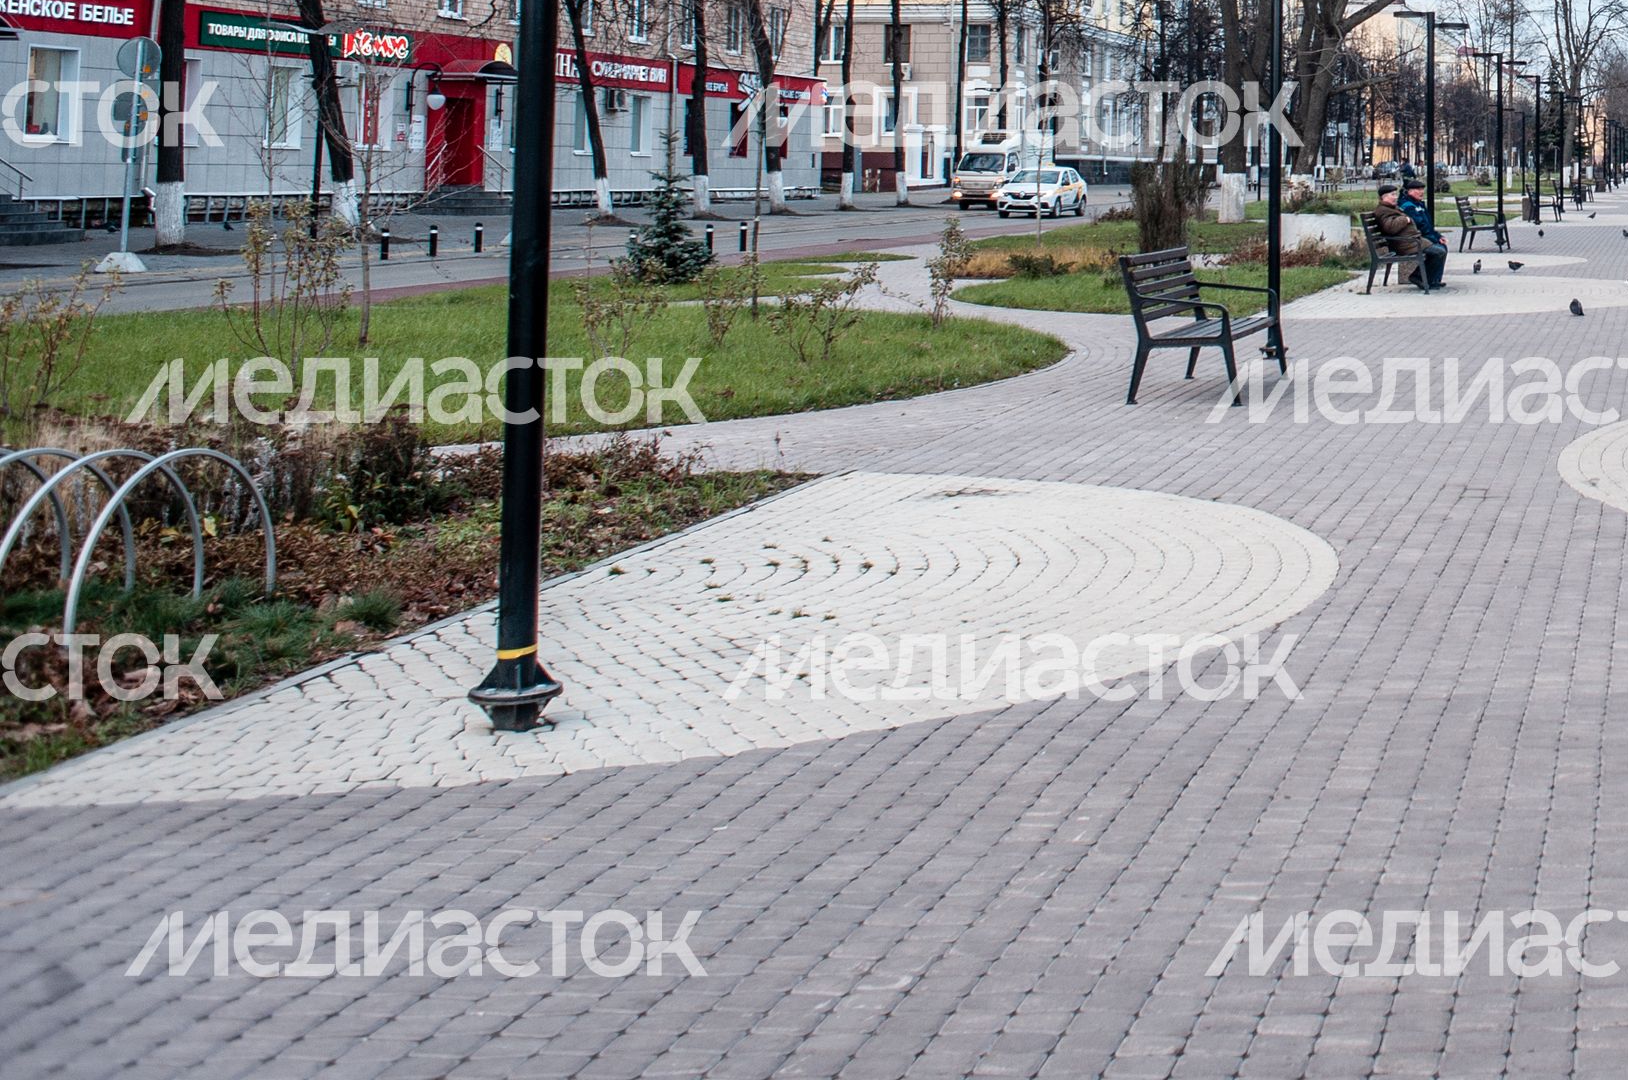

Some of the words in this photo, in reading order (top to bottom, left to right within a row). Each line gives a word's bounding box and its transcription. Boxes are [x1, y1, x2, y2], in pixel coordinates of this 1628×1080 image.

[80, 4, 135, 25] БЕЛЬЕ
[207, 23, 247, 38] ТОВАРЫ
[247, 27, 267, 41] ДЛЯ
